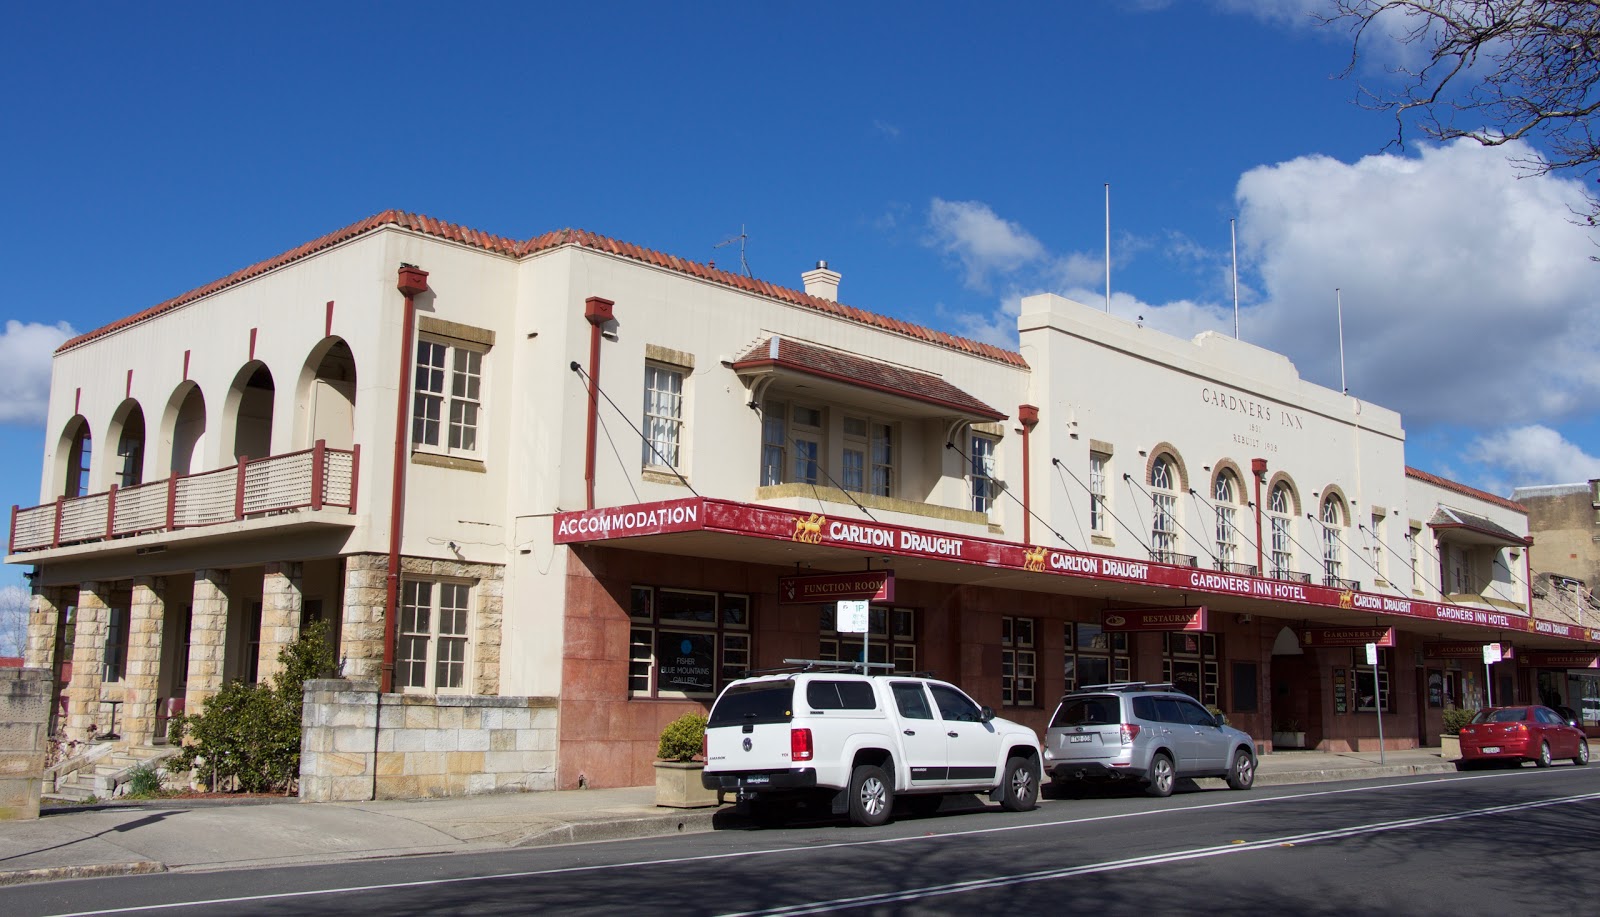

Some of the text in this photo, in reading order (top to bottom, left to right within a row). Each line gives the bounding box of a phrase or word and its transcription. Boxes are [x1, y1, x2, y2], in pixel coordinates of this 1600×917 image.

[1281, 411, 1303, 430] INN
[1233, 433, 1259, 448] REBUILT
[558, 505, 698, 535] ACCOMMODATION
[829, 521, 963, 556] CARLTON DRAUGHT
[1050, 552, 1149, 580] CARLTON DRAUGHT
[804, 580, 884, 593] FUNCTION ROOM
[1190, 573, 1306, 600] GARDNERS INN HOTEL
[1353, 593, 1411, 613] CARLTON DRAUGHT
[1143, 614, 1198, 622] RESTAURANT
[1436, 606, 1509, 626] GARDNERS INN HOTEL
[1323, 629, 1388, 638] GARDNERS INN
[1535, 620, 1568, 635] CARLTON DRAUGHT
[676, 657, 696, 666] FISHER
[660, 666, 710, 675] BLUE MOUNTAINS
[672, 676, 698, 684] GALLERY
